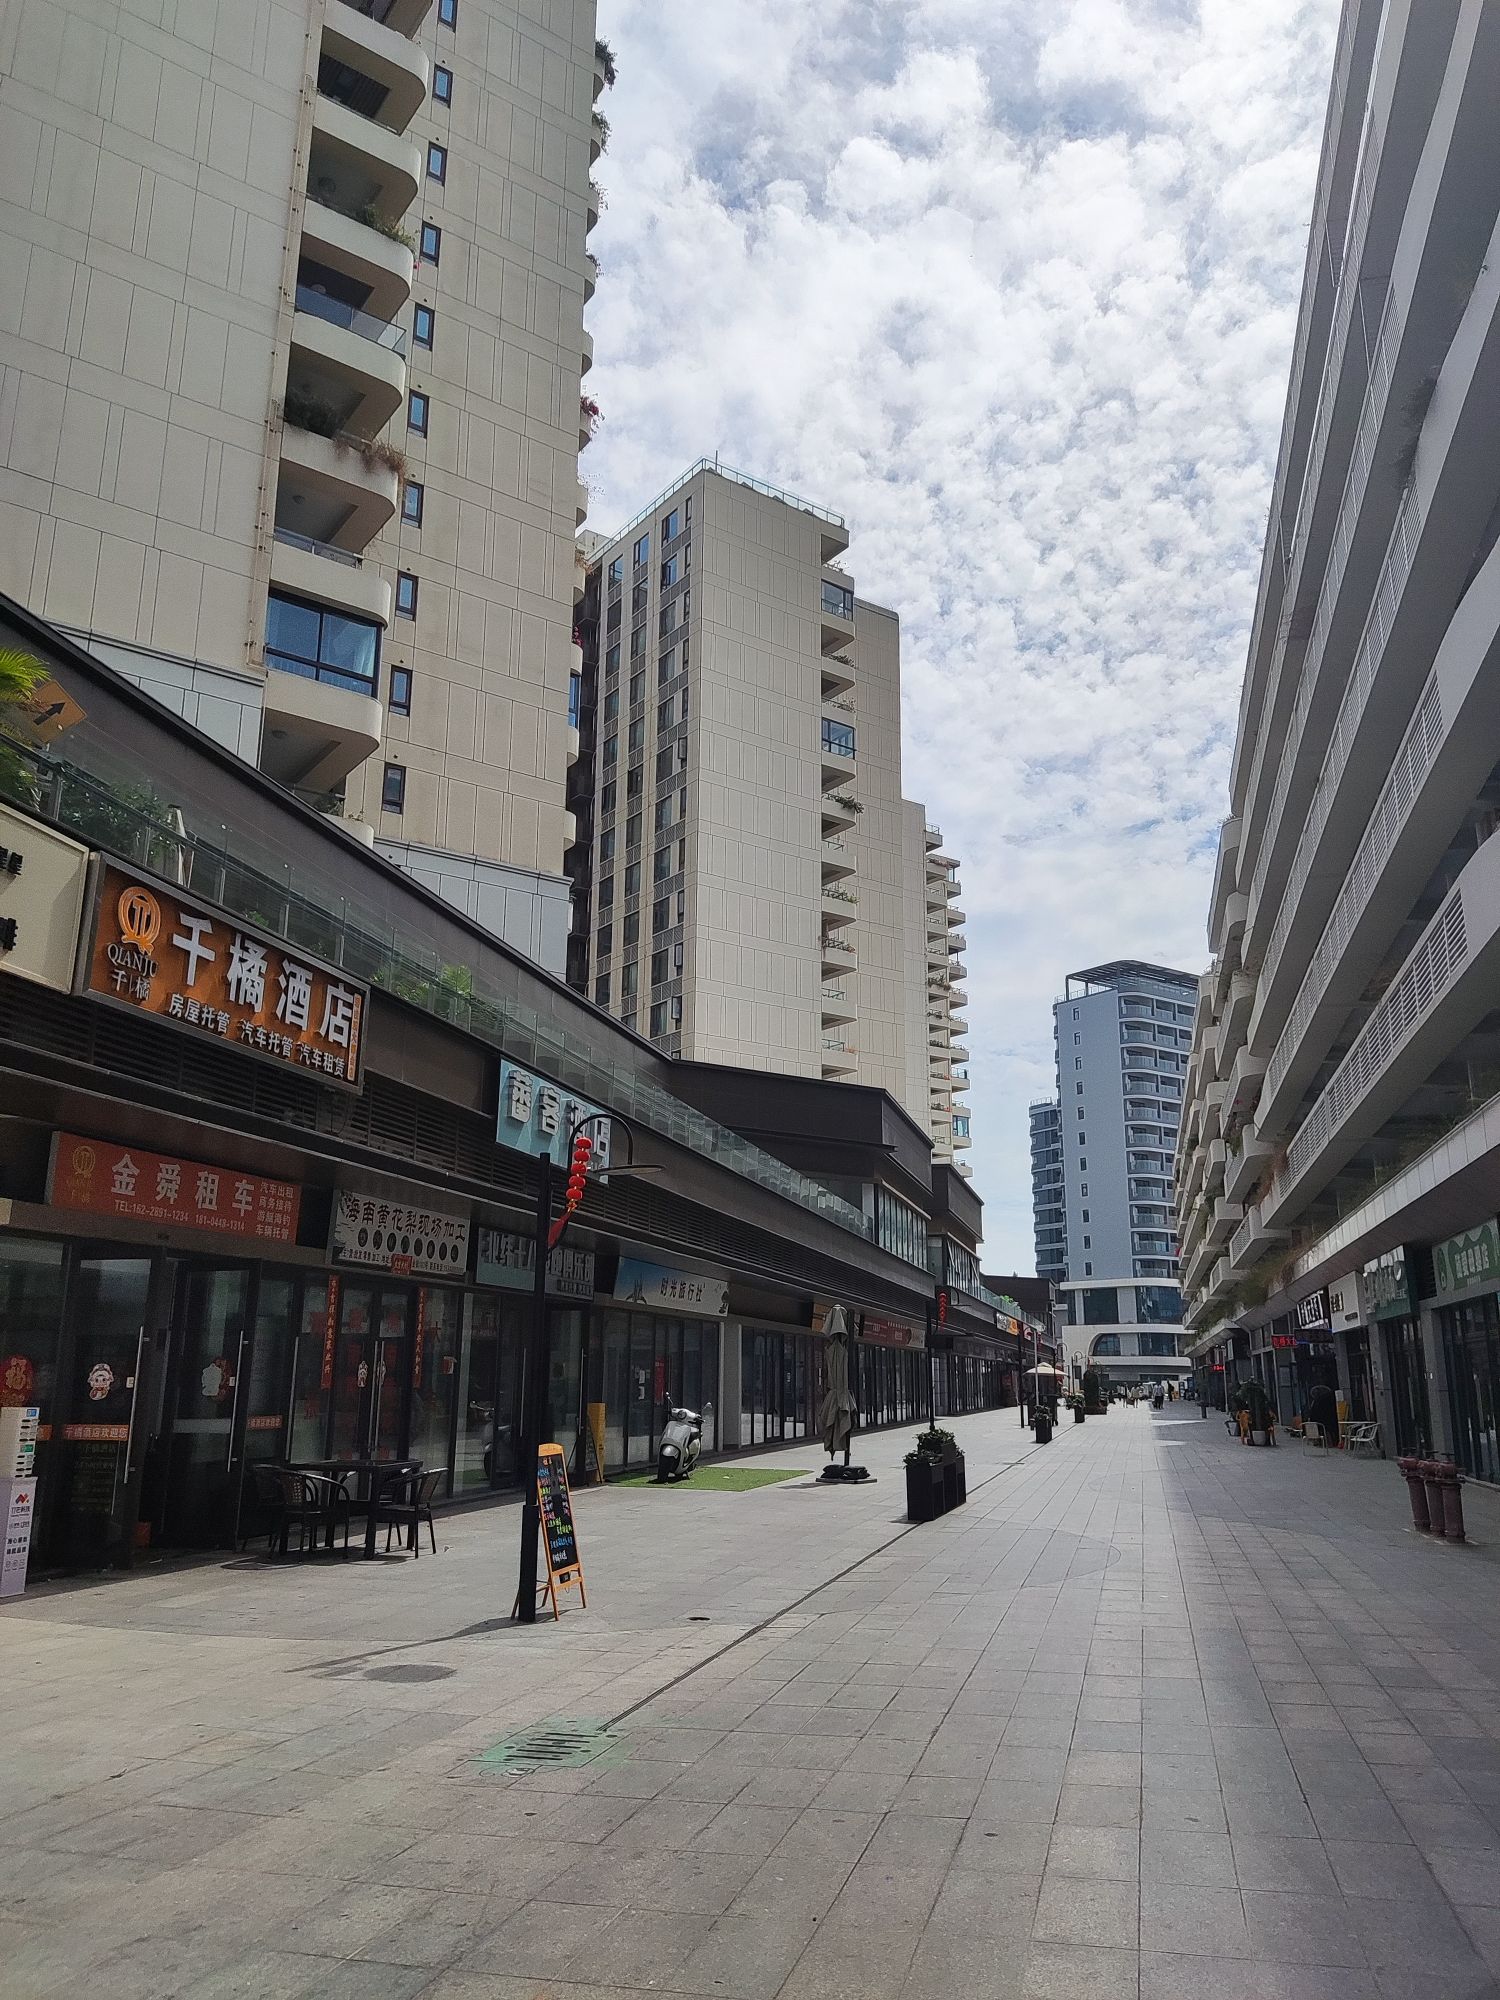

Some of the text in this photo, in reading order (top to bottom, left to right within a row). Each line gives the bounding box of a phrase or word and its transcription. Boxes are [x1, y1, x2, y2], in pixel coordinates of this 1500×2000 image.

[107, 942, 159, 978] QIANJU
[172, 912, 356, 1049] 千橘酒店
[168, 993, 347, 1079] 房屋托管 汽车托管 汽车租赁
[111, 1153, 254, 1217] 金舜租车
[260, 1181, 294, 1198] 汽车出租
[346, 1197, 466, 1242] 海南黄花梨现场加工
[660, 1277, 704, 1302] 时光旅行社
